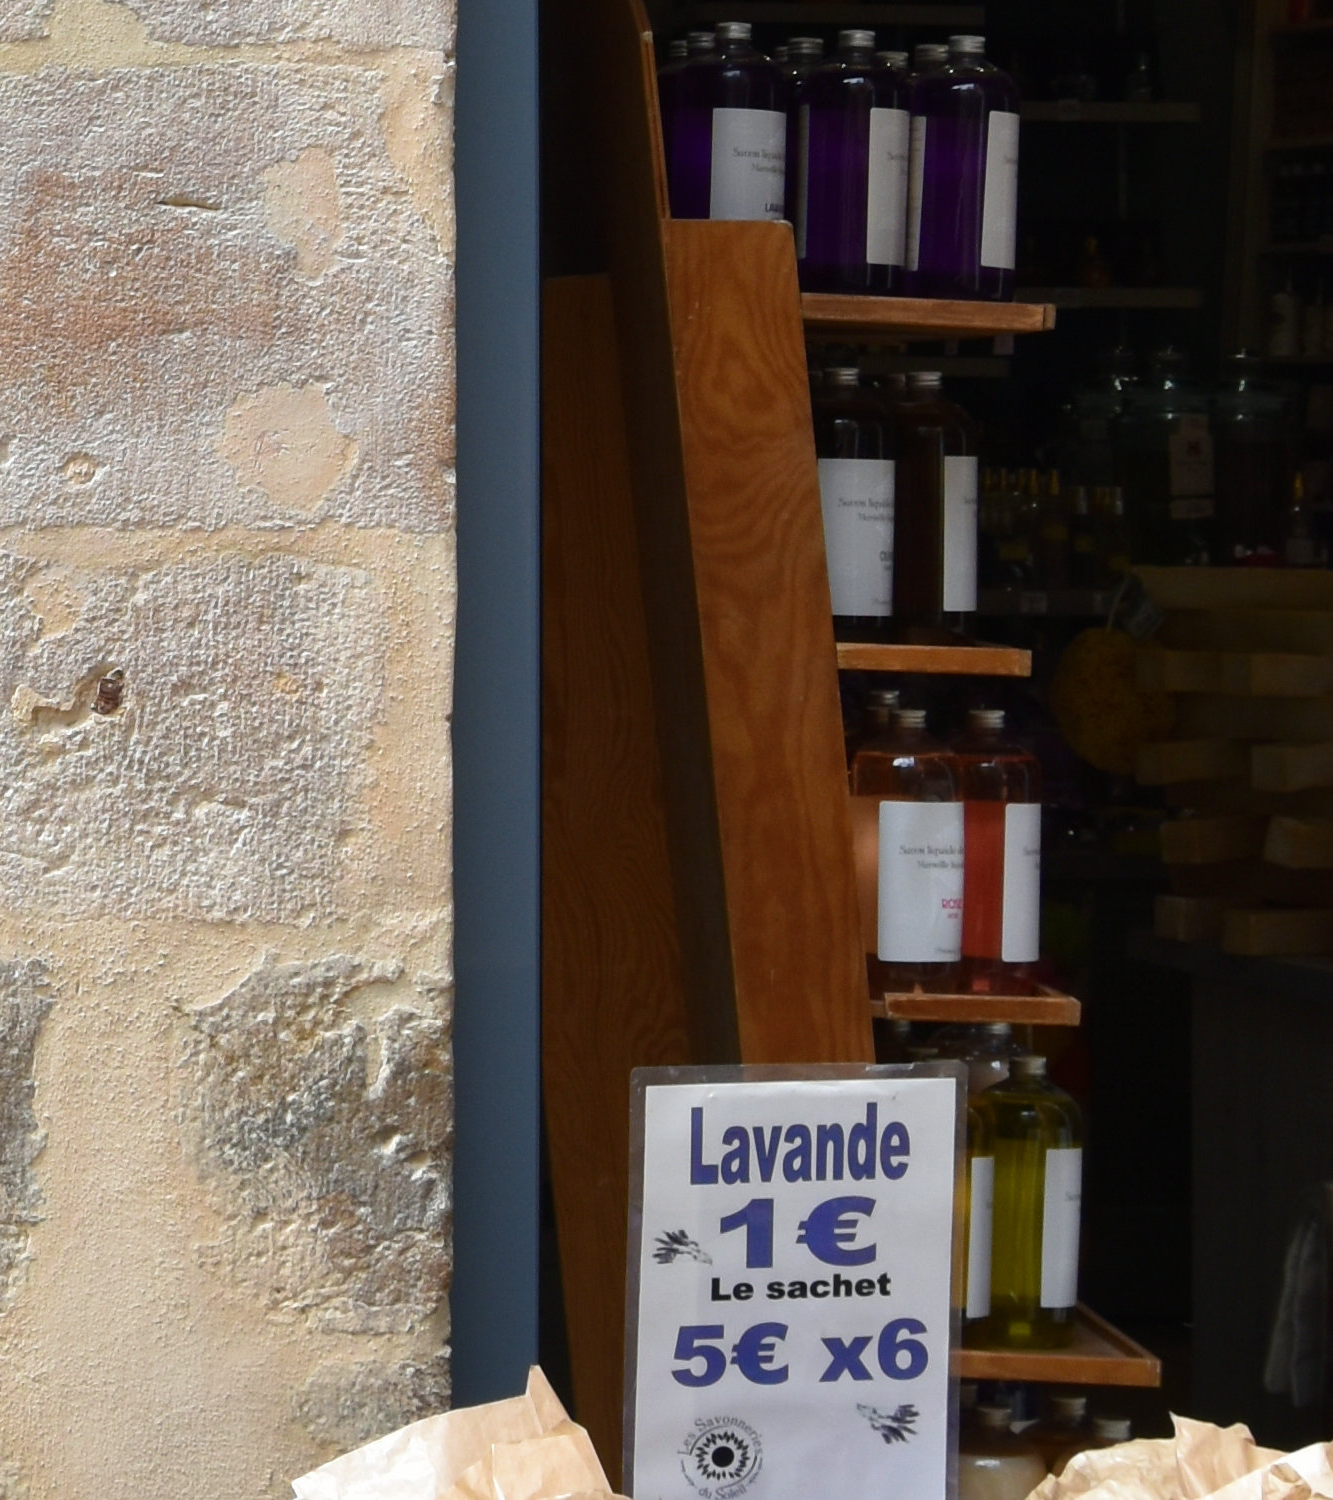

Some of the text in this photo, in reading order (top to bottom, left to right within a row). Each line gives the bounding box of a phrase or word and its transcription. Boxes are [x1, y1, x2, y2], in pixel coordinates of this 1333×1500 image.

[689, 1101, 911, 1186] Lavande
[719, 1195, 878, 1270] 1€
[710, 1272, 891, 1302] Le sachet
[670, 1317, 929, 1387] 5€ x6
[677, 1415, 764, 1455] Les Savonneries
[698, 1484, 747, 1500] du Soleil
